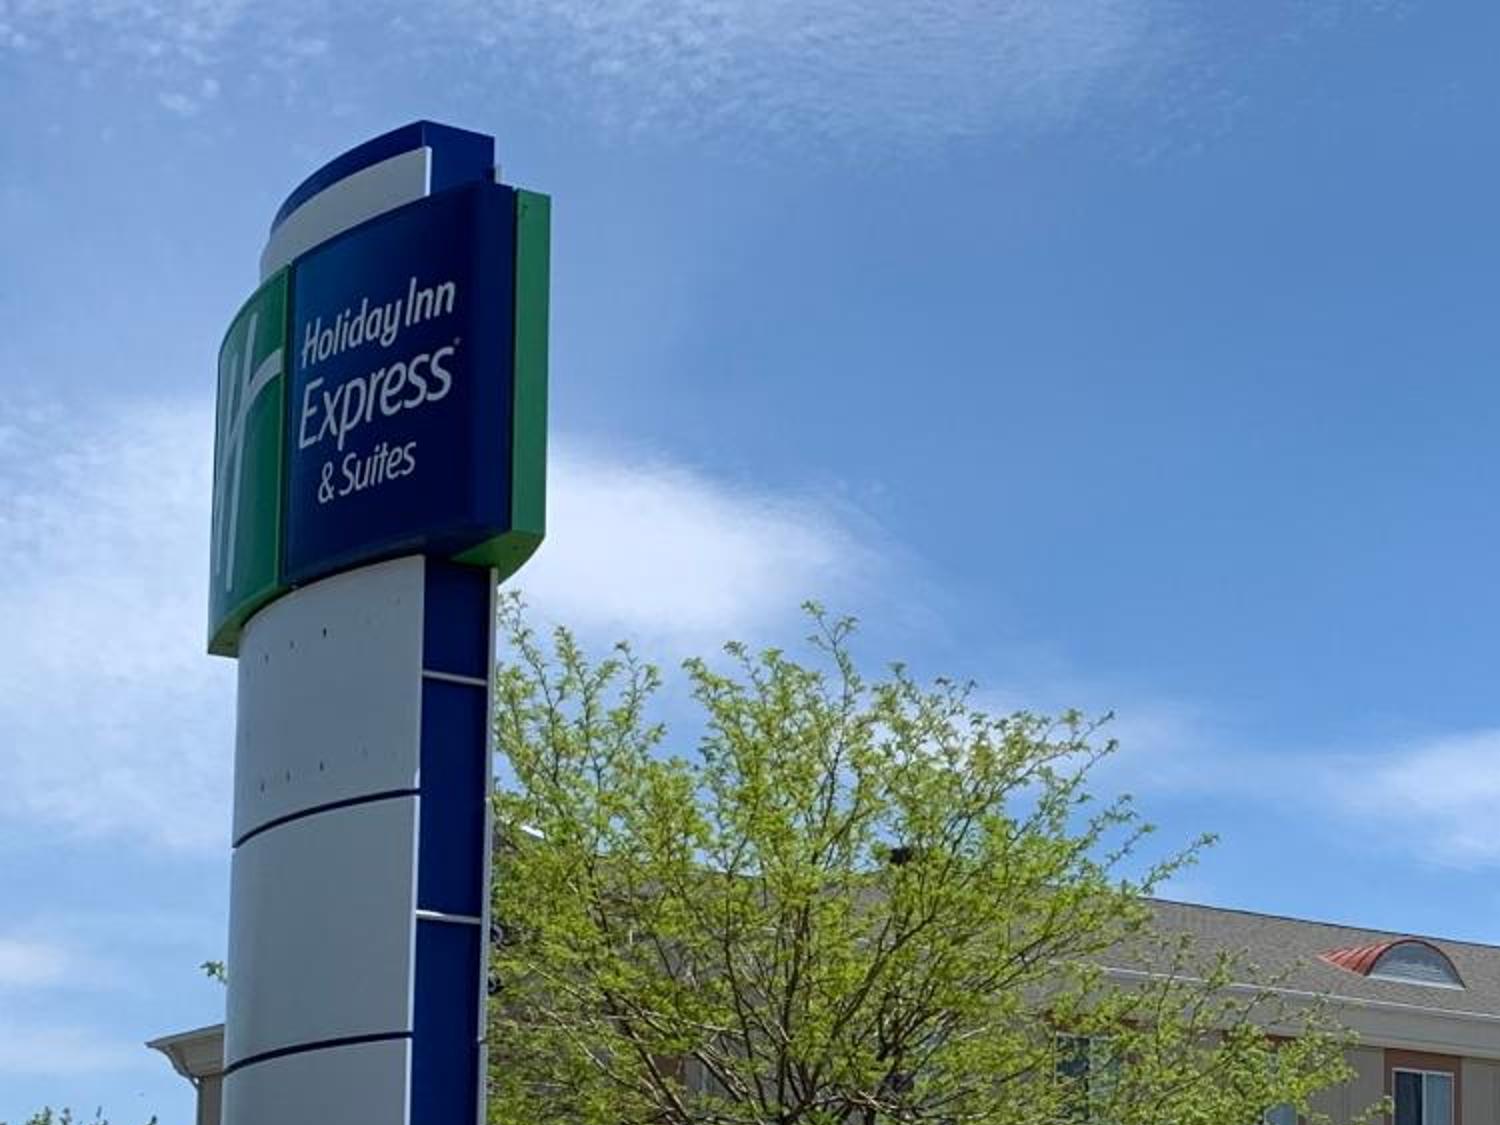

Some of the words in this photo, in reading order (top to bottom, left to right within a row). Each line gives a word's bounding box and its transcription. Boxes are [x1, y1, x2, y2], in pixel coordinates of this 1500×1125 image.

[302, 297, 402, 369] Holiday
[405, 276, 456, 327] Inn
[299, 346, 455, 451] Express
[318, 461, 335, 503] &
[338, 441, 417, 496] Suites
